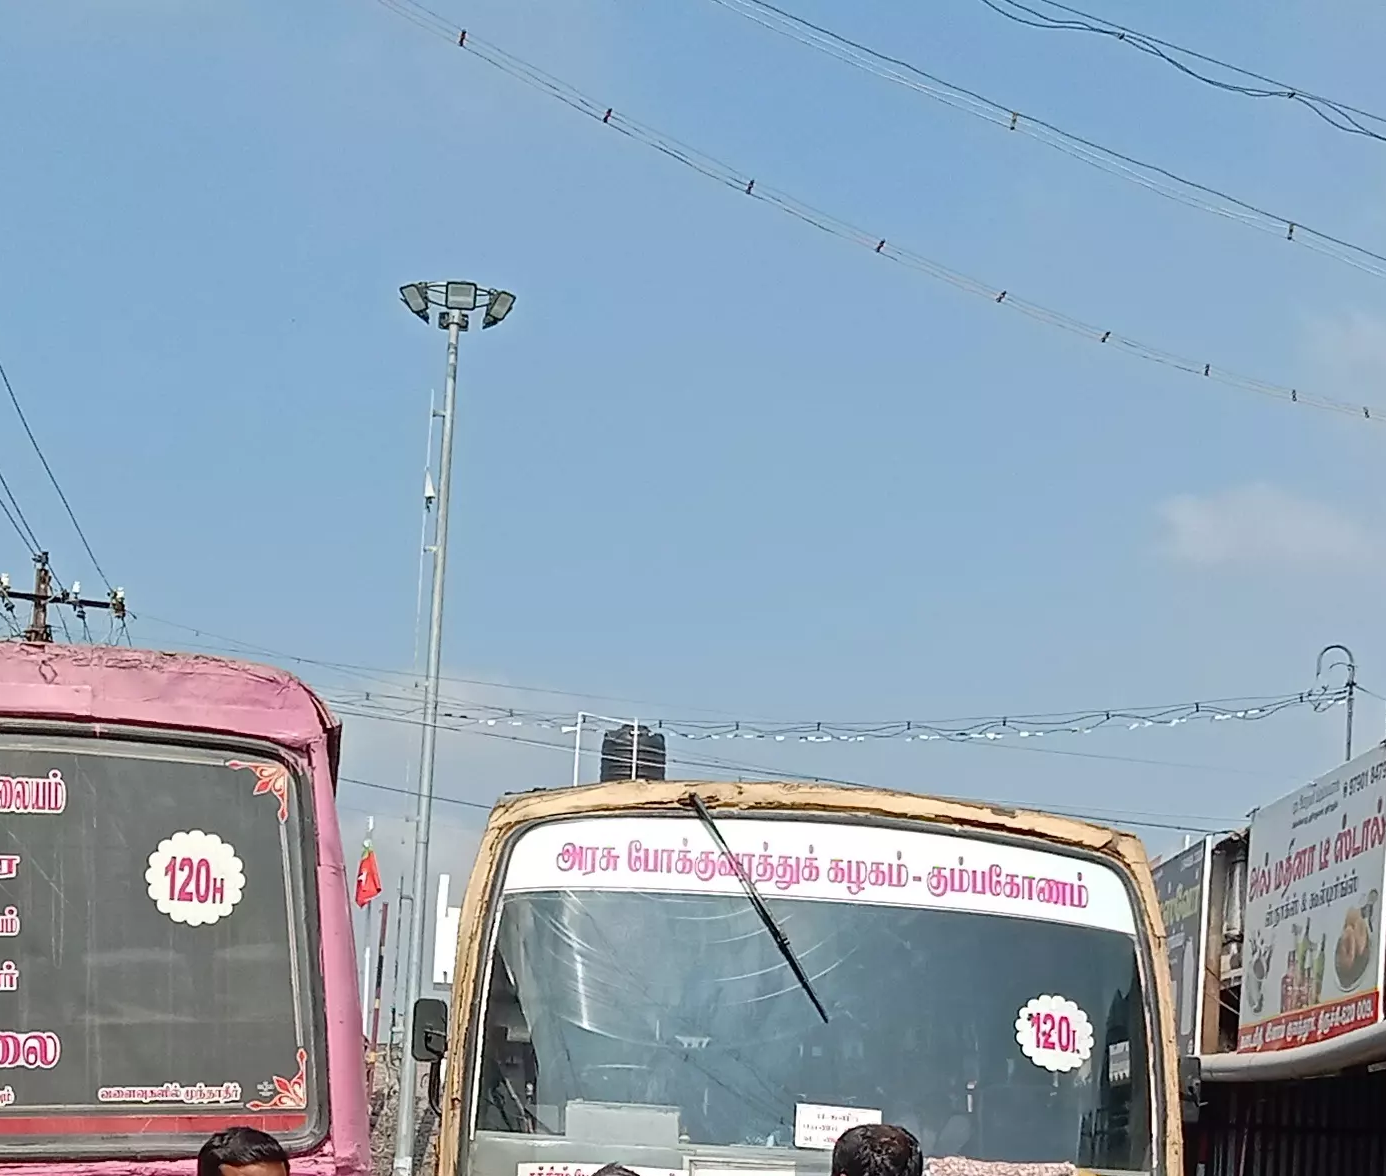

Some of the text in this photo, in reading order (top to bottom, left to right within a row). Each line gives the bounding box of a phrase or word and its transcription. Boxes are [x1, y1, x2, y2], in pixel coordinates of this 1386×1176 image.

[164, 855, 225, 904] 120H
[556, 842, 620, 876] அரசு
[627, 838, 821, 890] போக்குவரத்துக்
[827, 850, 909, 895] கழகம்
[926, 855, 1090, 909] கும்பகோணம்
[1249, 852, 1271, 902] அல்
[1273, 838, 1317, 899] மதீனா
[1319, 837, 1330, 871] டீ
[1334, 798, 1386, 864] ஸ்டால்
